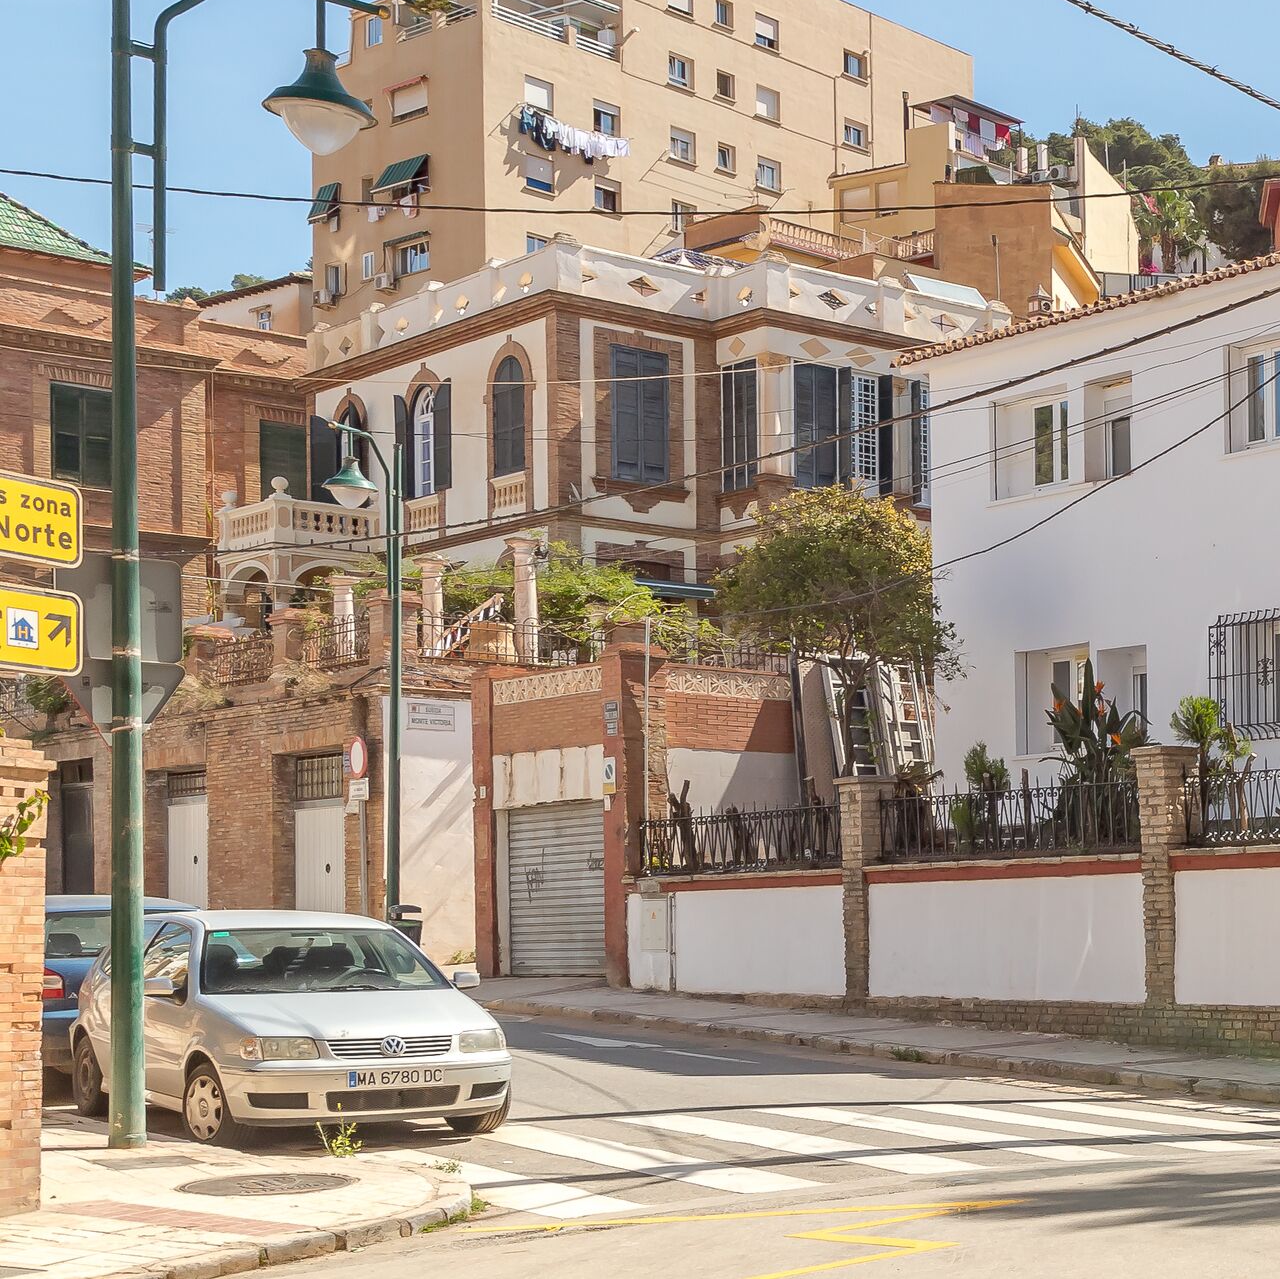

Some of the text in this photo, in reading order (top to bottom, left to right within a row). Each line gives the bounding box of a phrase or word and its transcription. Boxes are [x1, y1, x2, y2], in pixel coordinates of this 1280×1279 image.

[20, 493, 71, 518] zona
[357, 1068, 442, 1086] MA 6780 DC
